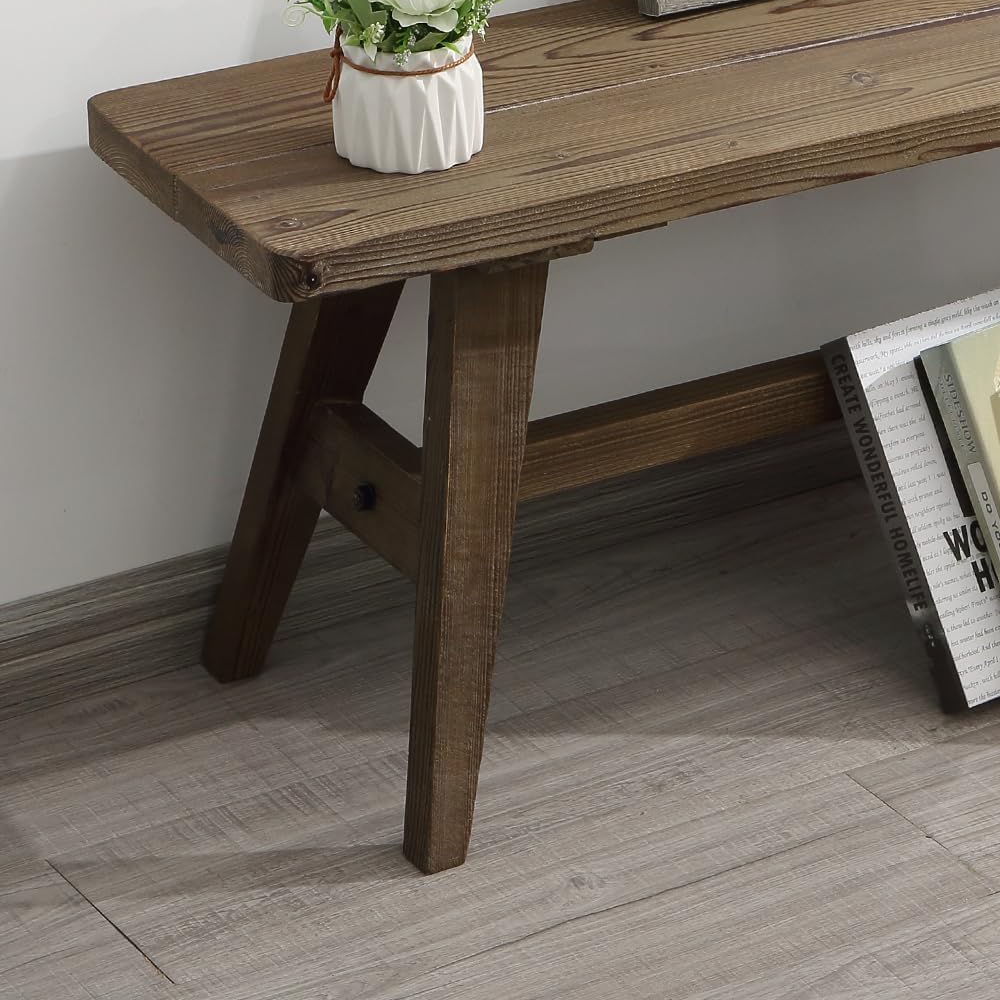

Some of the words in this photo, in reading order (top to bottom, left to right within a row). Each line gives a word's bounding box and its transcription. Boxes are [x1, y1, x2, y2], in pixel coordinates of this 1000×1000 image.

[944, 374, 977, 454] SIDESHOW
[832, 355, 861, 414] CREATE
[853, 417, 898, 523] WONDERFUL
[889, 527, 928, 611] HOMELIFE
[981, 491, 994, 514] DO
[971, 558, 999, 592] H
